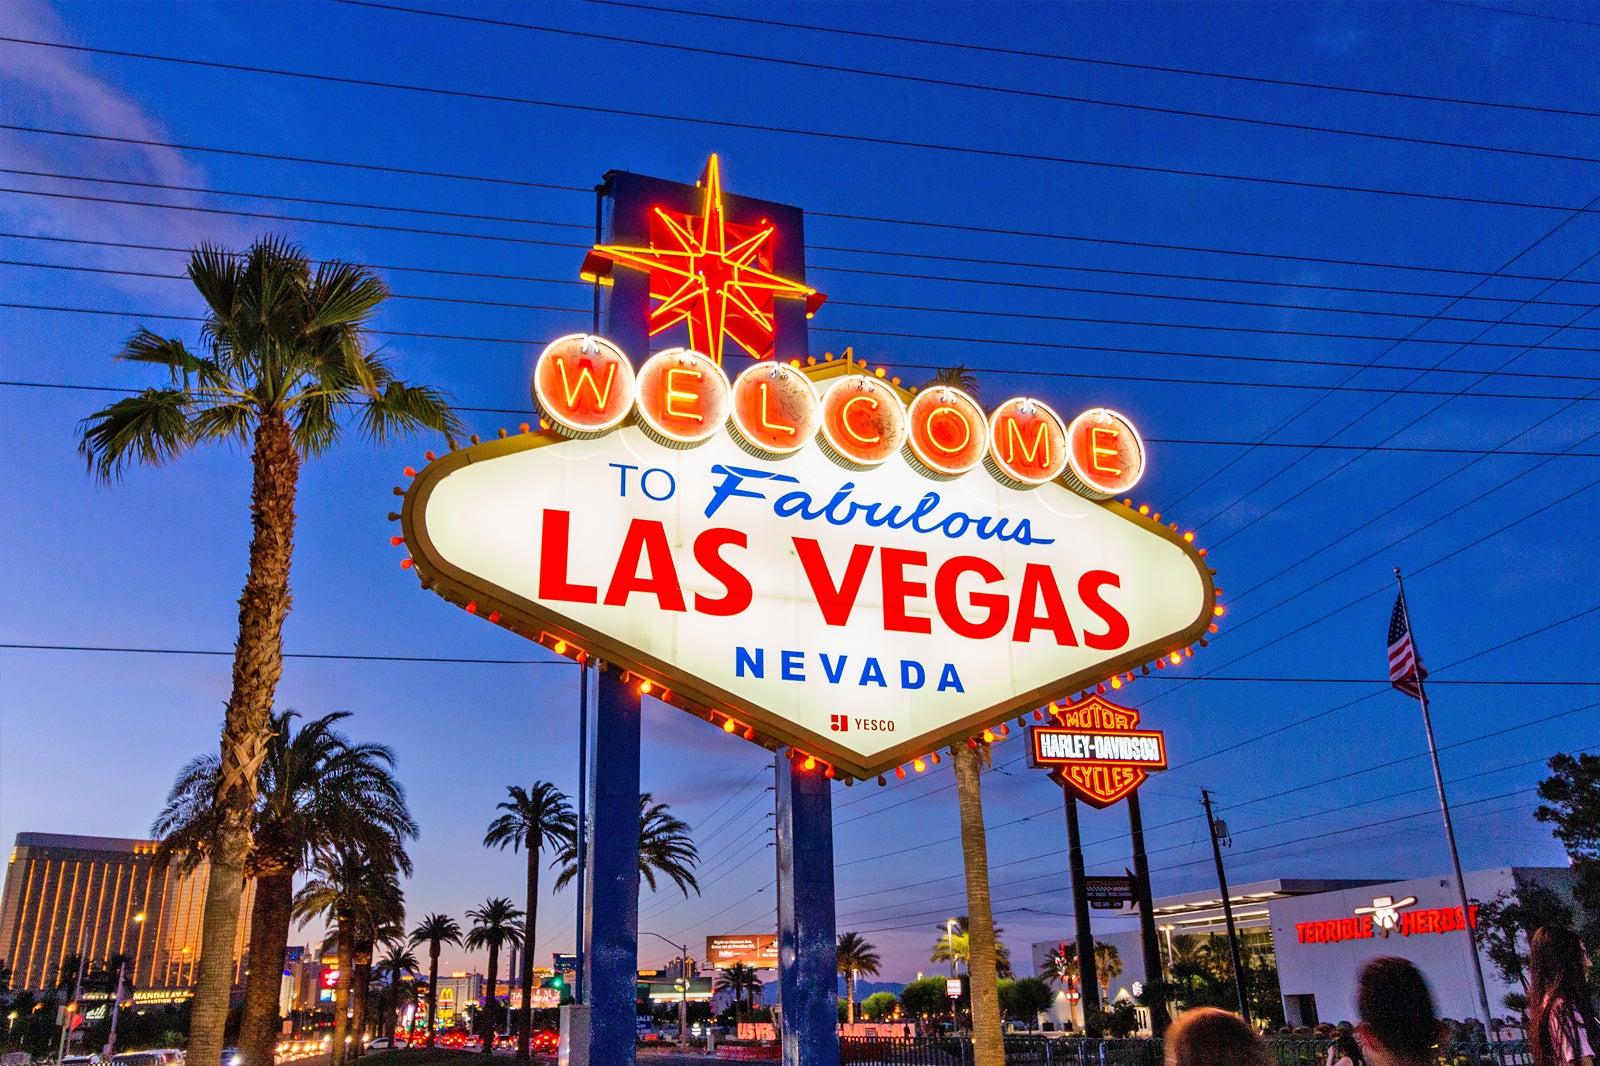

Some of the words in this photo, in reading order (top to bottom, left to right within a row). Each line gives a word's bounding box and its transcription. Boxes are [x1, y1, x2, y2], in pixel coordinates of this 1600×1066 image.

[550, 350, 1126, 482] WELCOME
[608, 462, 676, 502] TO
[704, 463, 1056, 545] Fabulous
[537, 508, 754, 617] LAS
[791, 535, 1131, 651] VEGAS
[735, 645, 965, 694] NEVADA
[855, 718, 895, 732] YESCO
[1065, 702, 1129, 730] MOTOR
[1040, 733, 1160, 761] HARLEY-DAVIDSON
[1070, 766, 1135, 796] CYCLES
[1295, 915, 1374, 944] TERRIBLE
